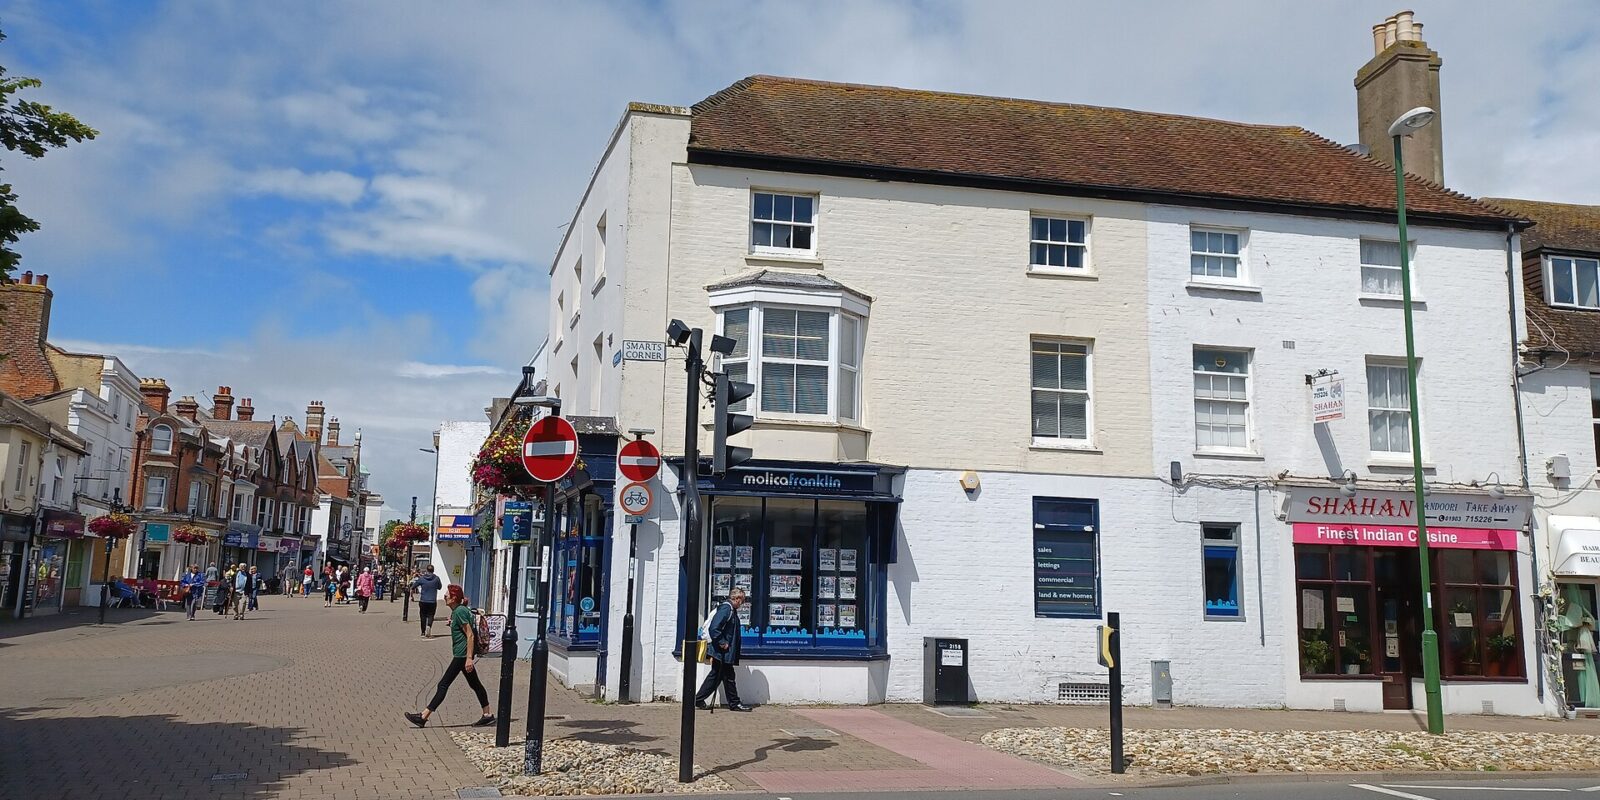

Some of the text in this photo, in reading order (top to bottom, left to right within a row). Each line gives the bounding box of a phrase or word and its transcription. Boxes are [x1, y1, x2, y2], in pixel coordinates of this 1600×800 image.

[626, 342, 662, 351] SMARTS
[625, 351, 662, 359] CORNER
[1314, 400, 1343, 411] SHAHAN
[743, 472, 840, 487] molicafranklin
[1306, 496, 1414, 518] SHAHAN
[1424, 502, 1518, 513] ANDOORI TAKE AWAY
[1465, 515, 1492, 523] 715226
[1317, 527, 1458, 543] Finest Indian Cisine
[1037, 561, 1060, 570] lettings
